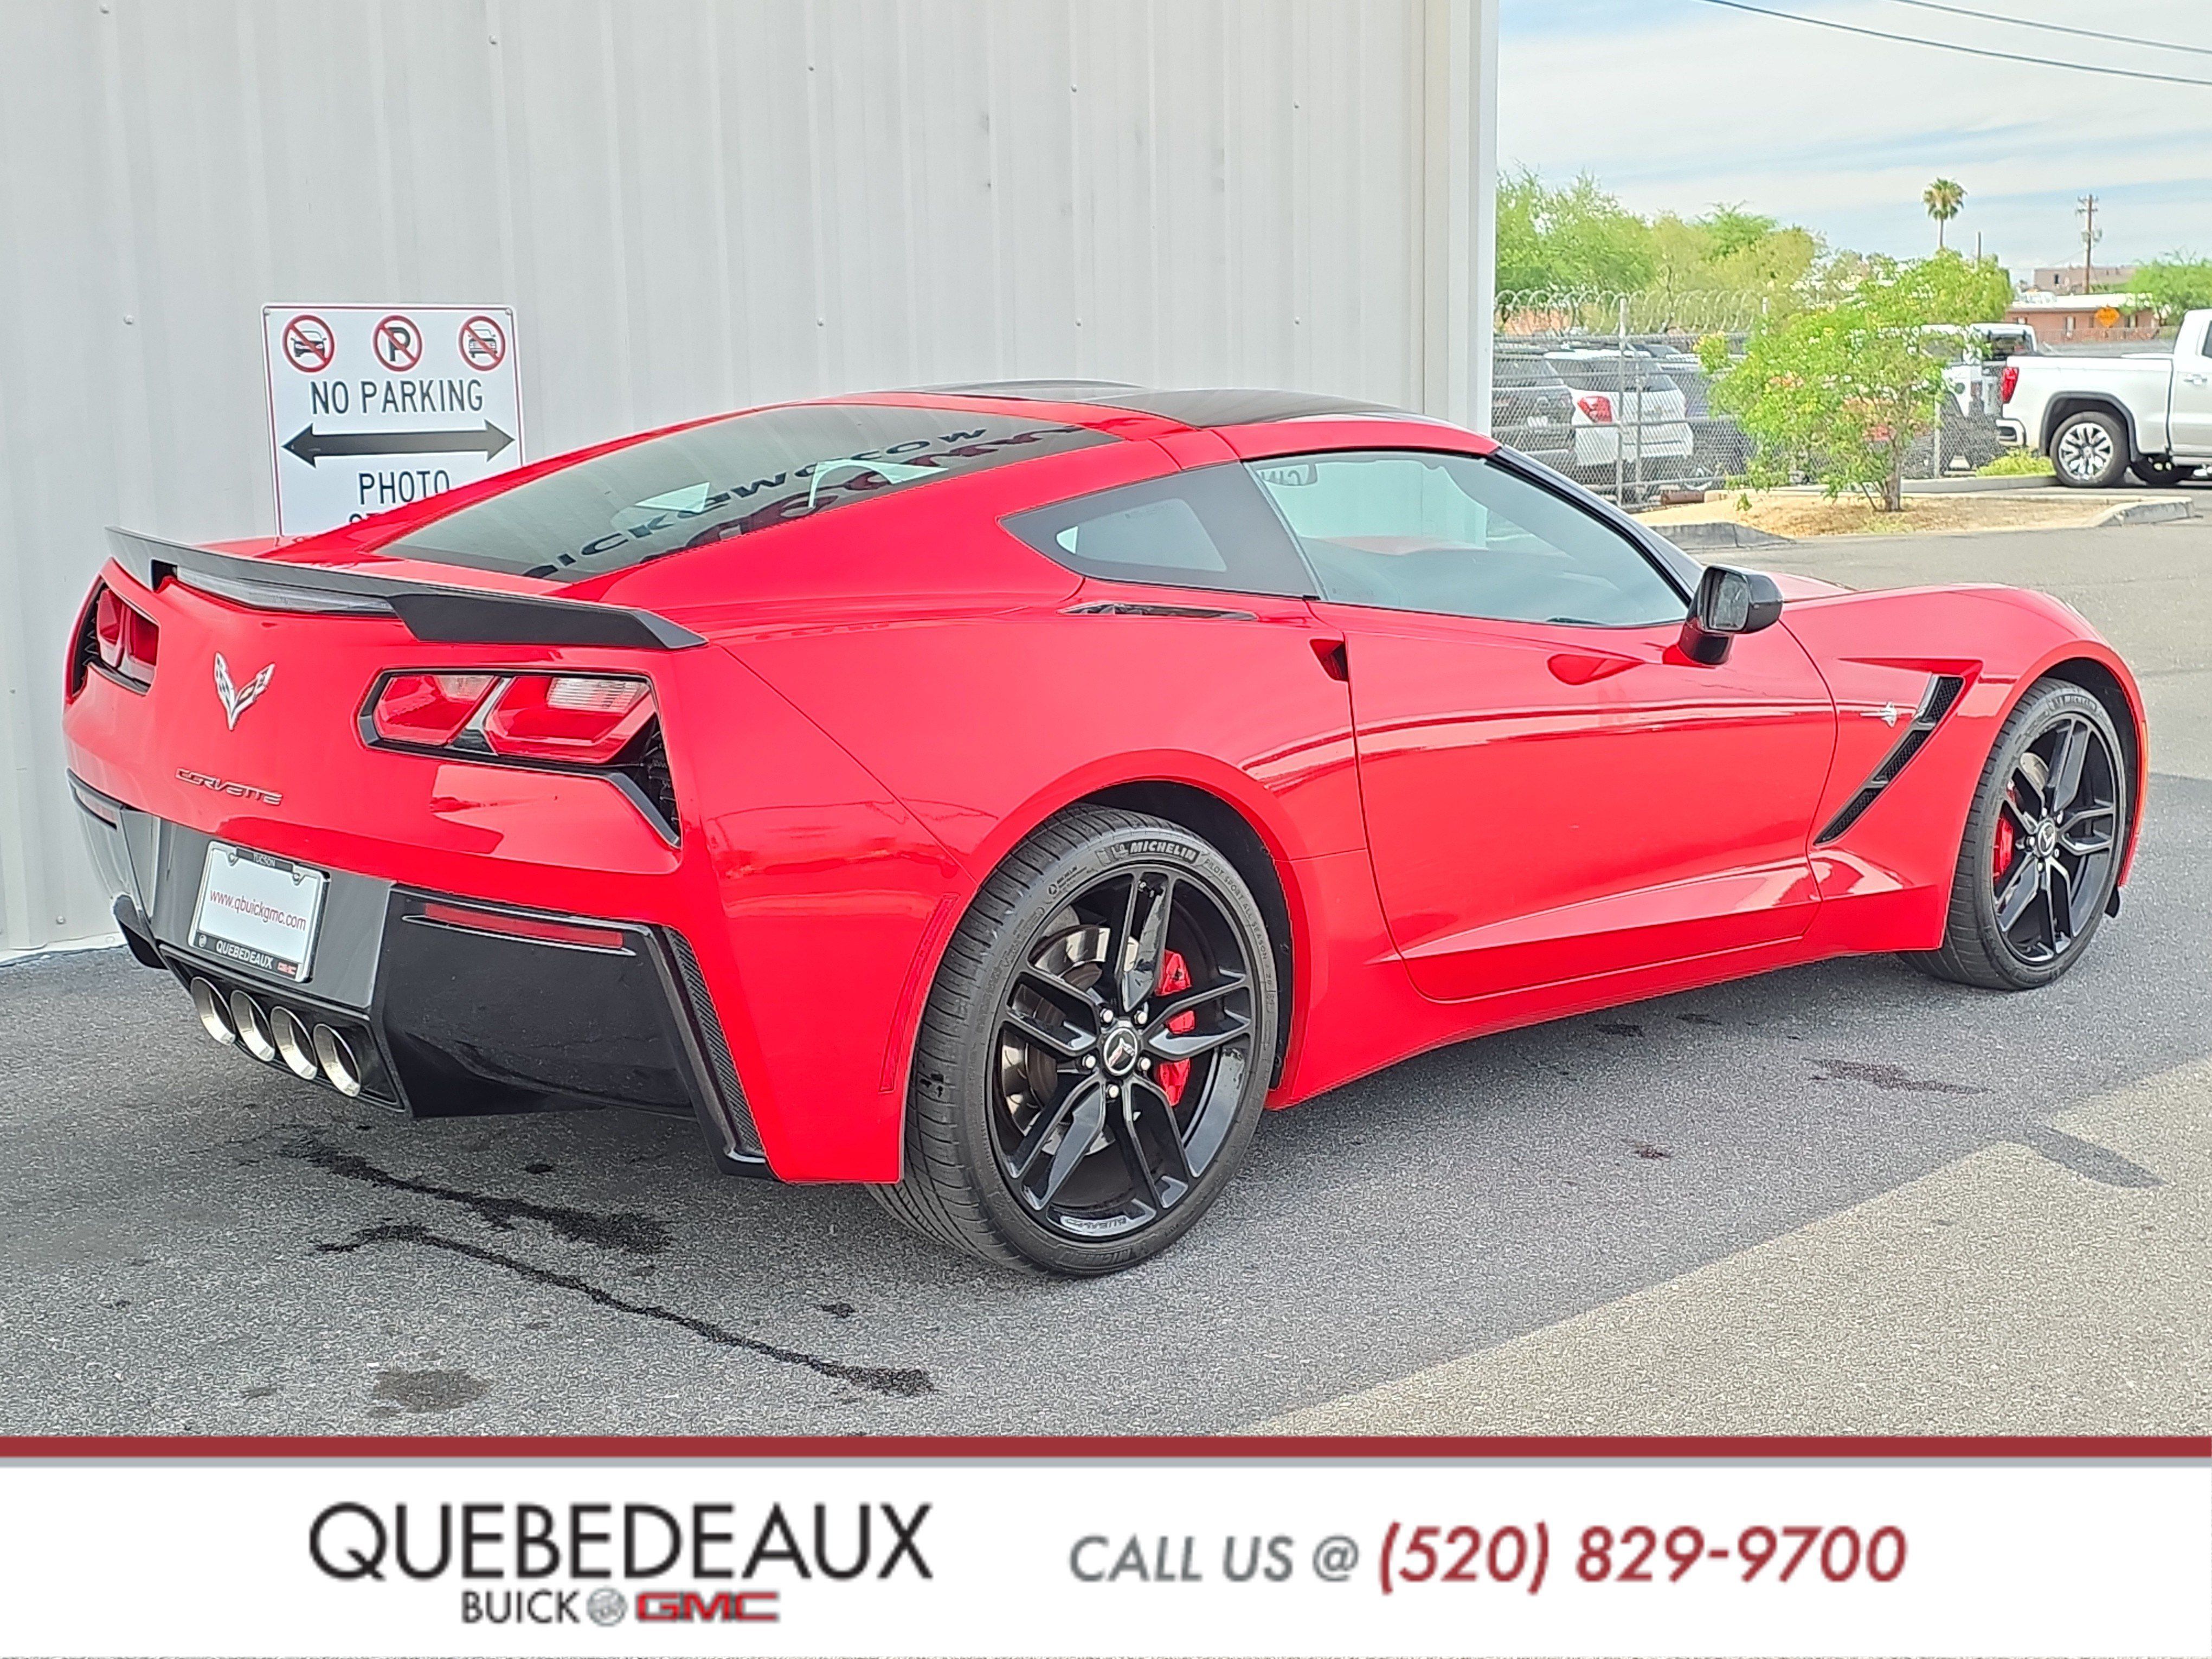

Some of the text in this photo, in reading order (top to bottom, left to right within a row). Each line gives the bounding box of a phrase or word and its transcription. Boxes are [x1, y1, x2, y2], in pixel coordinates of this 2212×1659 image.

[310, 379, 483, 414] NO PARKING
[359, 470, 450, 505] PHOTO
[175, 767, 283, 806] CORVETTE
[1130, 840, 1197, 861] MICHELIN
[1204, 858, 1224, 879] PILOT
[210, 890, 306, 931] www.qbuickgmc.com
[216, 940, 273, 969] QUEBEDEAUX
